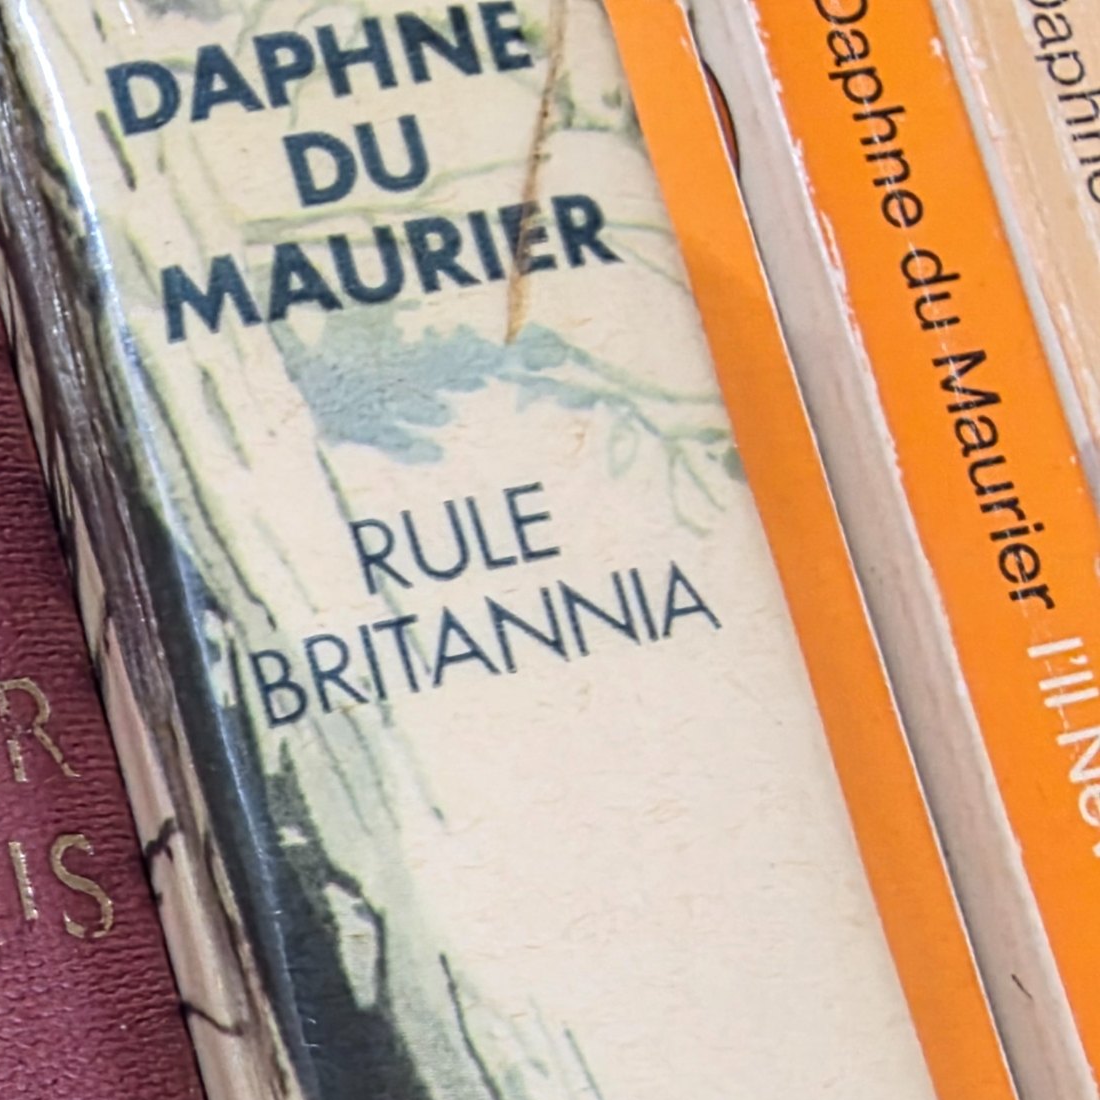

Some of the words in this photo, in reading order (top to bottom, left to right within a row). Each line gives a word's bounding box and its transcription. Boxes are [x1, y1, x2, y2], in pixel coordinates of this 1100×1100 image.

[105, 0, 534, 136] DAPHNE
[1027, 0, 1100, 205] aphn
[282, 114, 431, 207] DU
[160, 195, 623, 343] MAURIER
[350, 482, 561, 594] RULE
[901, 249, 961, 331] du
[932, 350, 1055, 610] Maurier
[1056, 724, 1100, 859] Ne
[249, 560, 722, 728] BRITANNIA
